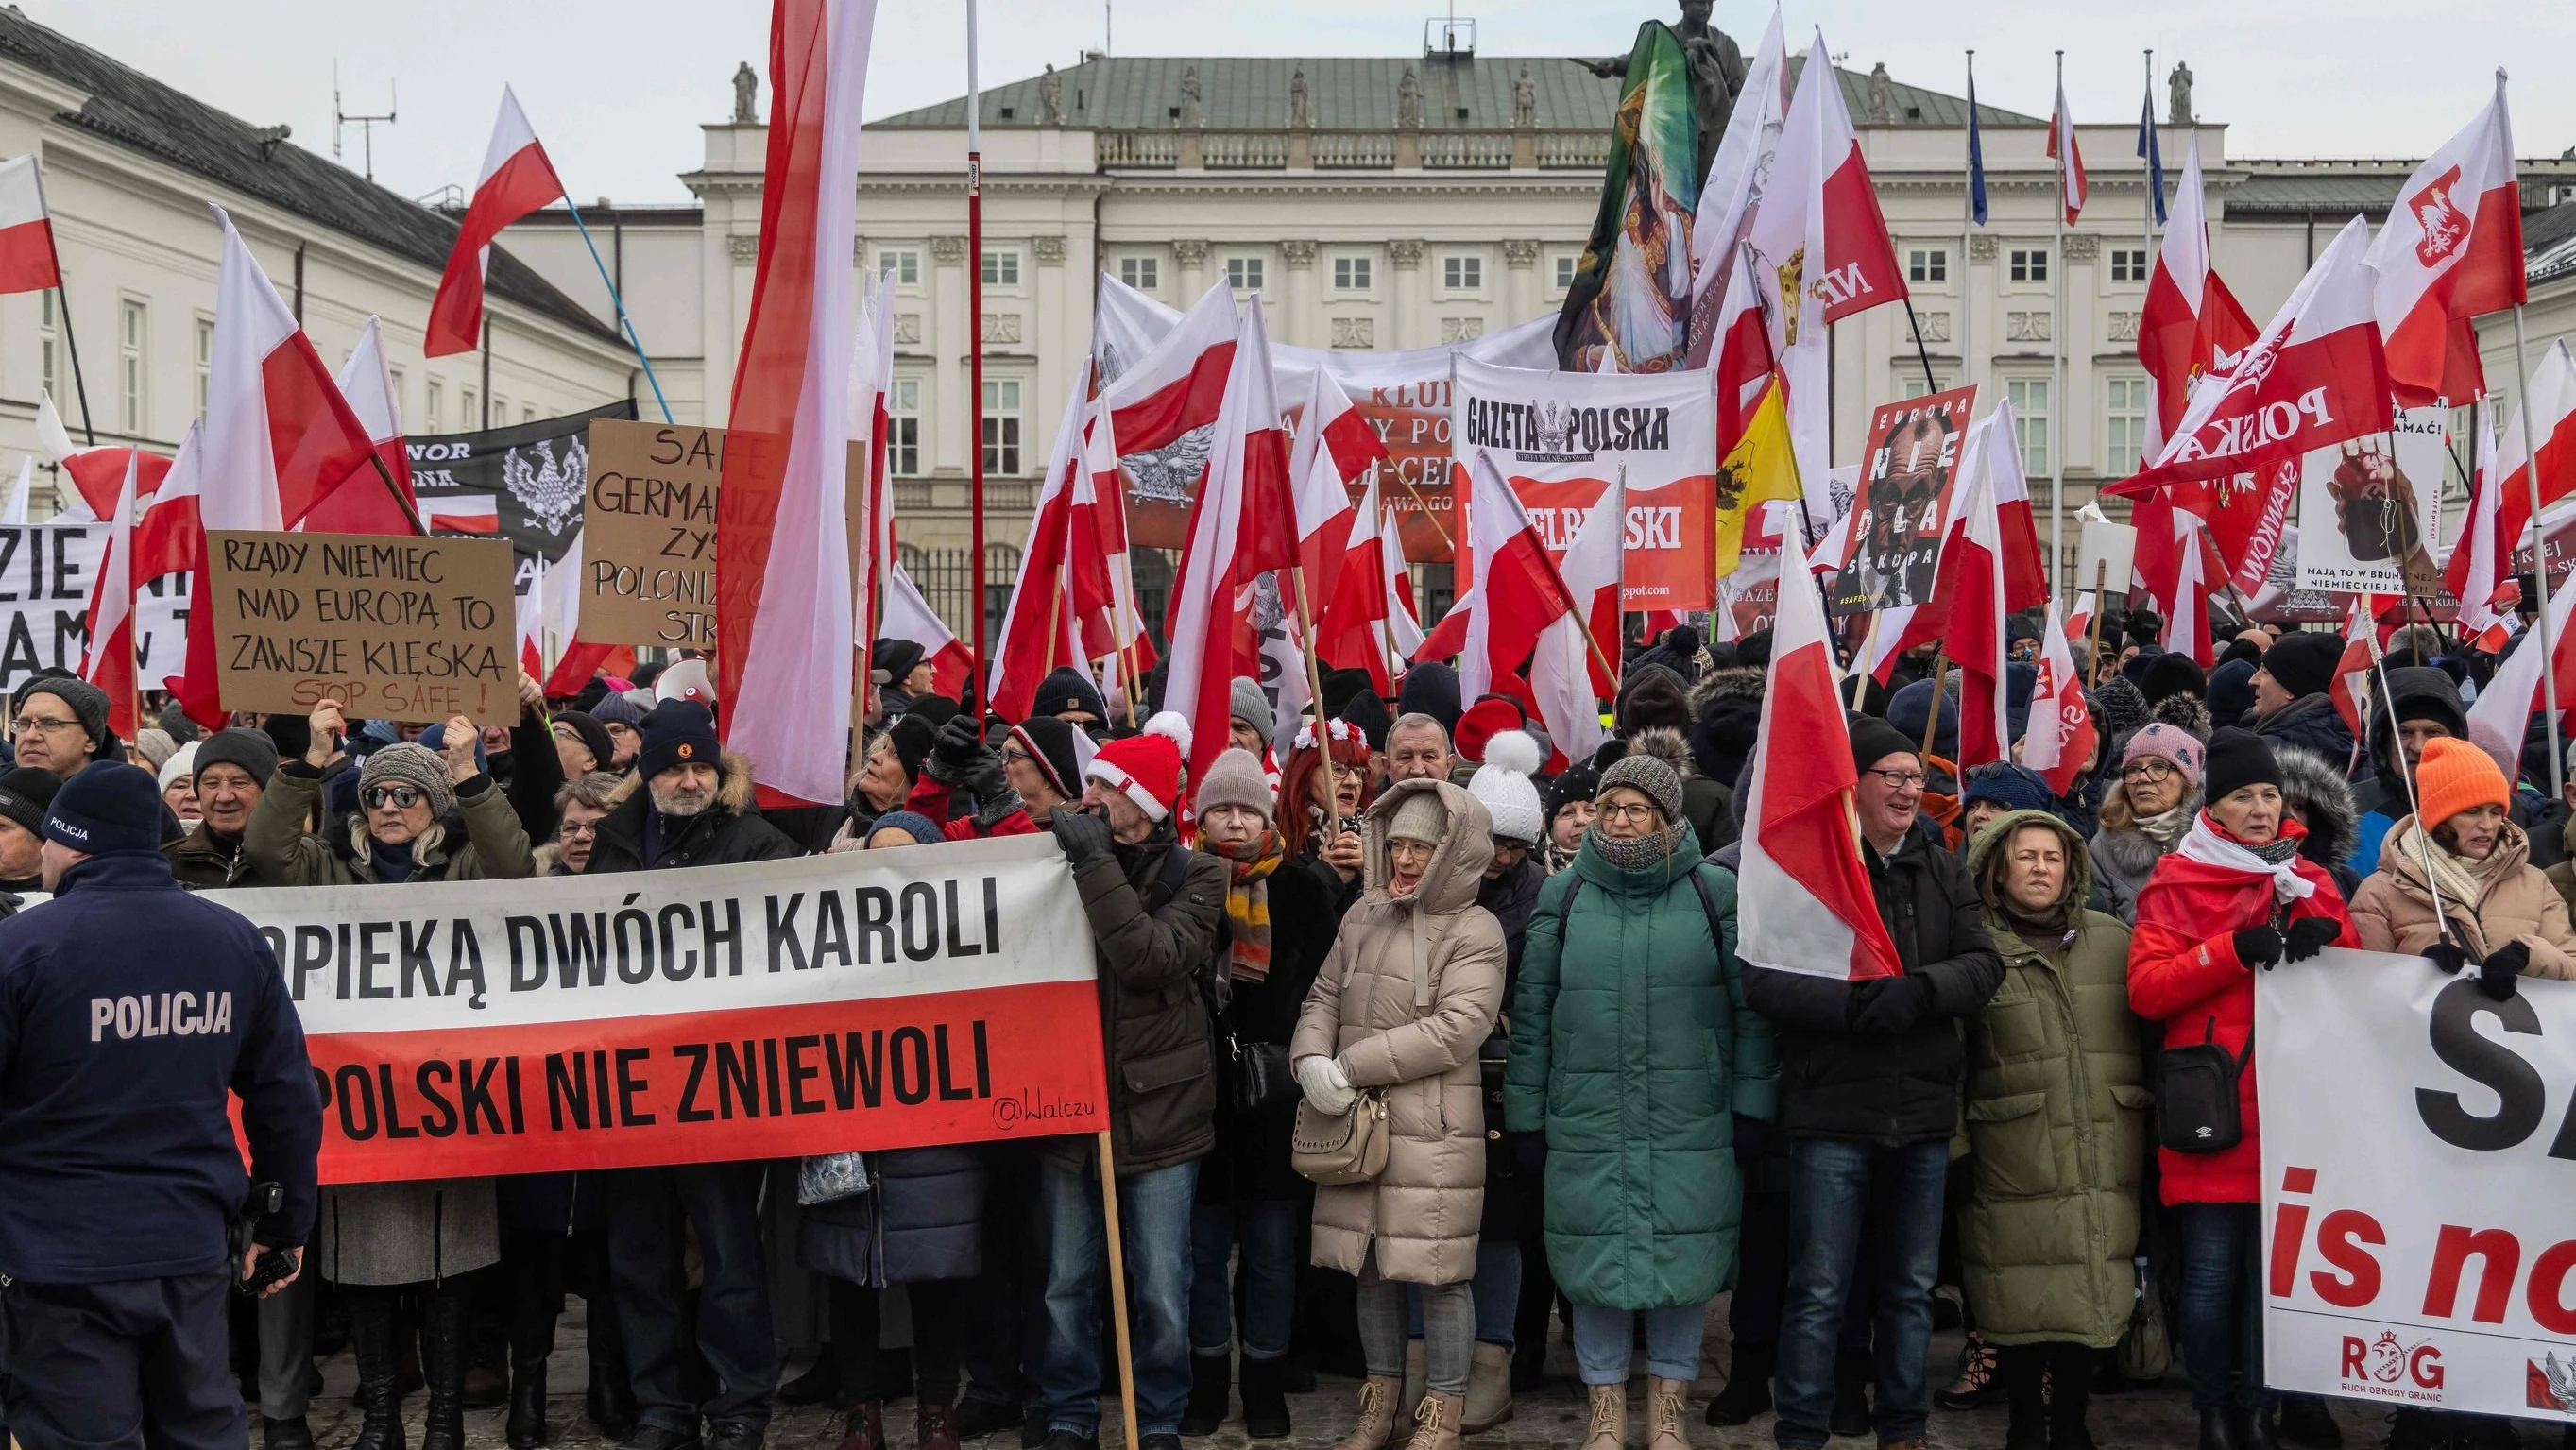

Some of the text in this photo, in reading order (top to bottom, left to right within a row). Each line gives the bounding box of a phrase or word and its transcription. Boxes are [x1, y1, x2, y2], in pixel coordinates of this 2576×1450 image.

[1468, 397, 1669, 452] GAZETA POLSKA
[1879, 398, 1967, 430] EUROPA
[412, 469, 460, 486] NA
[1869, 431, 1960, 481] NIE
[1855, 499, 1938, 542] DLA
[224, 539, 443, 584] RZĄDY NIEMIEC
[1847, 549, 1933, 575] SZKOPA
[2307, 568, 2336, 579] MAJĄ
[2339, 569, 2354, 577] TO
[2358, 570, 2369, 578] W
[2311, 579, 2387, 591] NIEMIECKIEJ
[237, 588, 494, 630] NAD EUROPĄ TO
[230, 634, 506, 681] ZAWSZE KLĘSKA
[291, 678, 366, 708] STOP
[382, 682, 463, 715] SAFE
[50, 816, 89, 842] POLICJA
[505, 892, 742, 992] DWÓCH
[765, 876, 1000, 974] KAROLI
[92, 990, 232, 1042] POLICJA
[545, 1047, 656, 1132] NIE
[673, 1019, 992, 1124] ZNIEWOLI
[2415, 977, 2576, 1159] S
[992, 1087, 1095, 1131] @Walczu
[2270, 1166, 2386, 1308] is
[2342, 1382, 2442, 1404] RUCH OBRONY GRANIC
